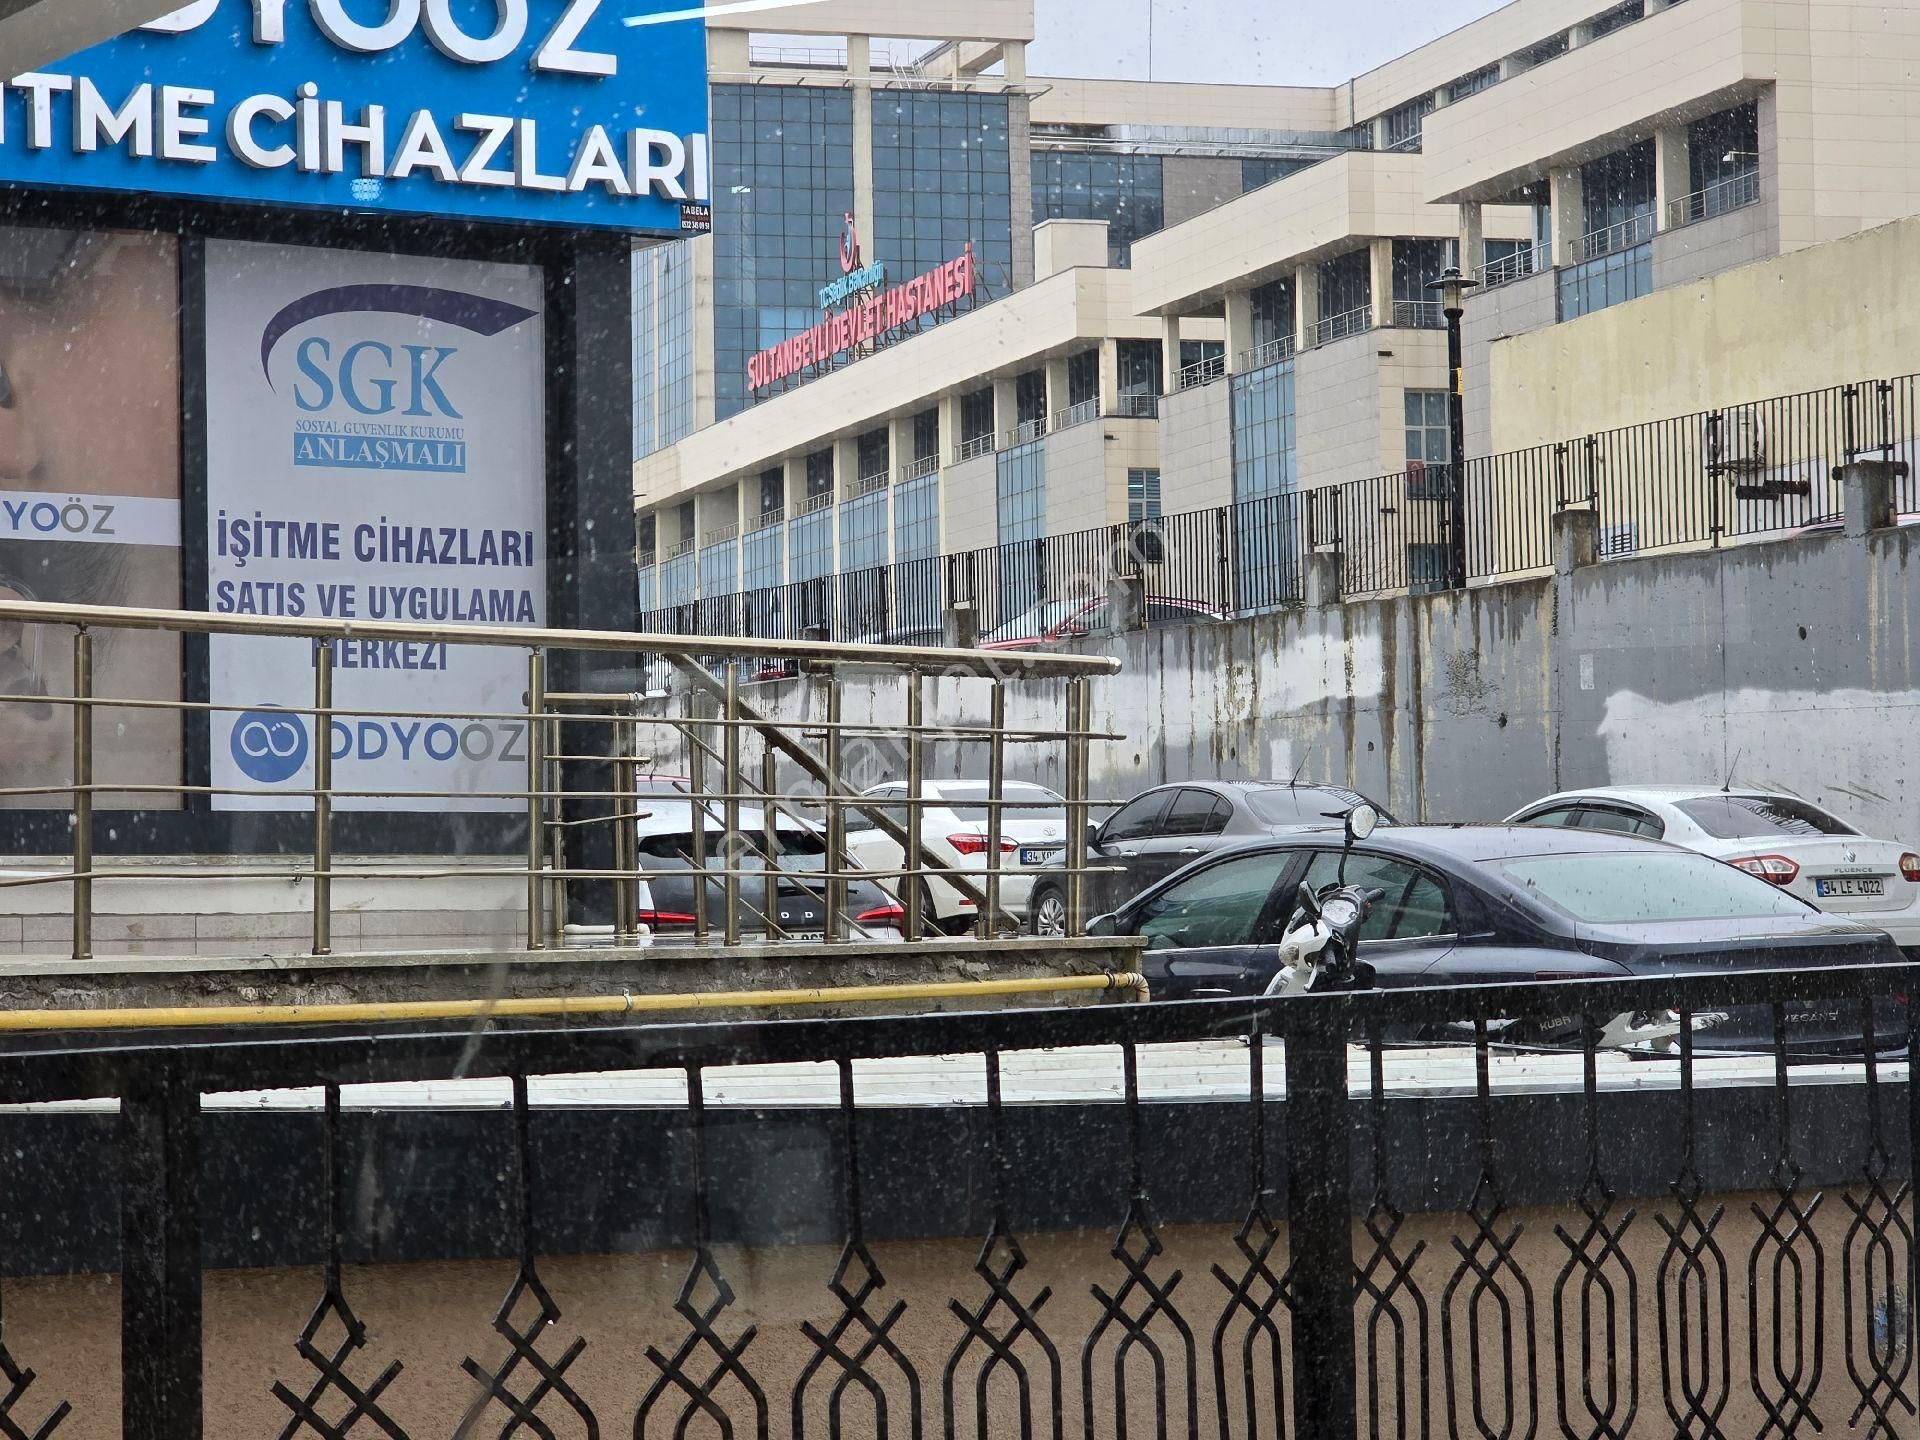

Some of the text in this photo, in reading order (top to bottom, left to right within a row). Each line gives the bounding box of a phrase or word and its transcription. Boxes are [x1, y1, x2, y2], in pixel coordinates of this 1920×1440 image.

[0, 72, 707, 200] TME CİHAZLARI
[682, 205, 708, 215] TABELA
[747, 241, 974, 391] SULTANBEYLİ DEVLET HASTANESİ
[293, 336, 464, 420] SGK
[296, 419, 340, 433] SOSYAL
[410, 425, 464, 440] KURUMU
[296, 436, 464, 468] ANLAŞMALI
[2, 497, 115, 535] YOÖZ
[217, 510, 534, 568] İŞİTME CİHAZLARI
[316, 584, 356, 618] VE
[369, 586, 536, 623] UYGULAMA
[1027, 851, 1038, 862] 34
[1824, 880, 1881, 894] 34 LE 4022
[1540, 1016, 1571, 1031] KUBA
